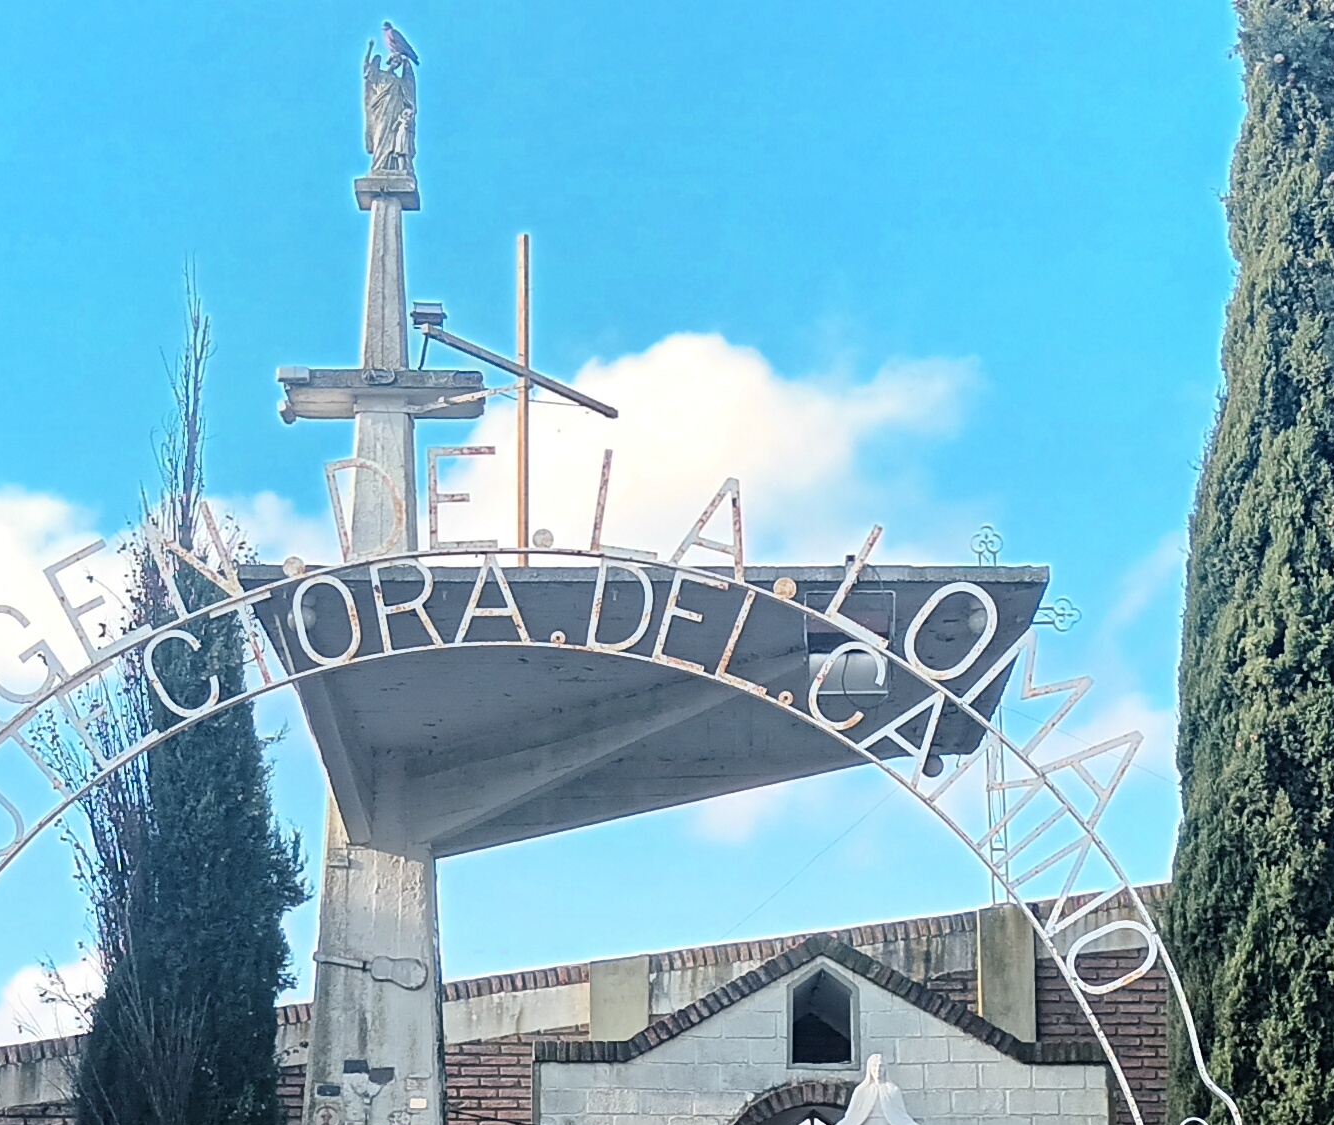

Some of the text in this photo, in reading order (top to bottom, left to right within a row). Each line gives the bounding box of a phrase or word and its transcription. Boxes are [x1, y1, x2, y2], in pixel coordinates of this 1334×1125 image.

[325, 445, 498, 562] DE
[591, 449, 745, 584] LA
[823, 524, 1145, 831] LOMA
[585, 555, 768, 697] DEL
[807, 640, 1159, 995] CAMINO
